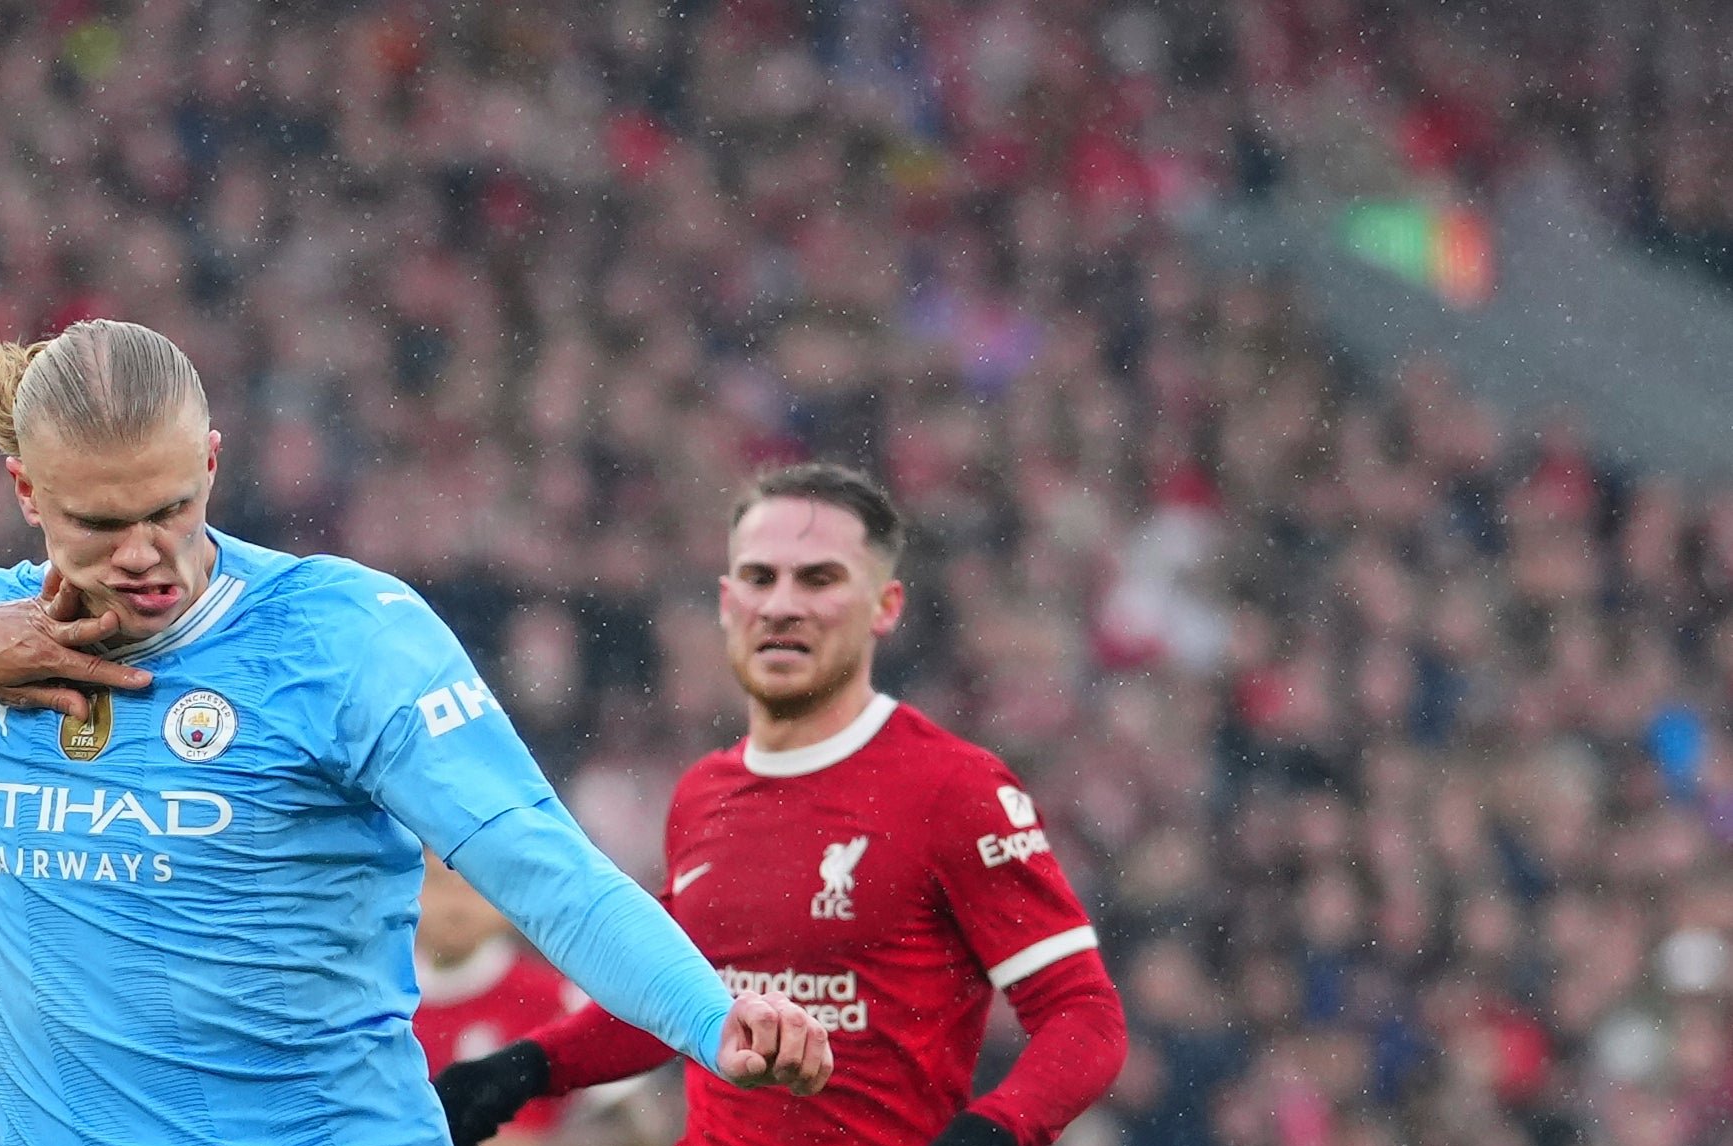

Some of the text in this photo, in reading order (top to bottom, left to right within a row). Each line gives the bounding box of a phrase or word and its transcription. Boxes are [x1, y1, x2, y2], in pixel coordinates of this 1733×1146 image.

[173, 693, 232, 718] MANCHESTER
[70, 735, 95, 747] FIFA
[186, 749, 209, 758] CITY
[716, 964, 857, 1003] tandard
